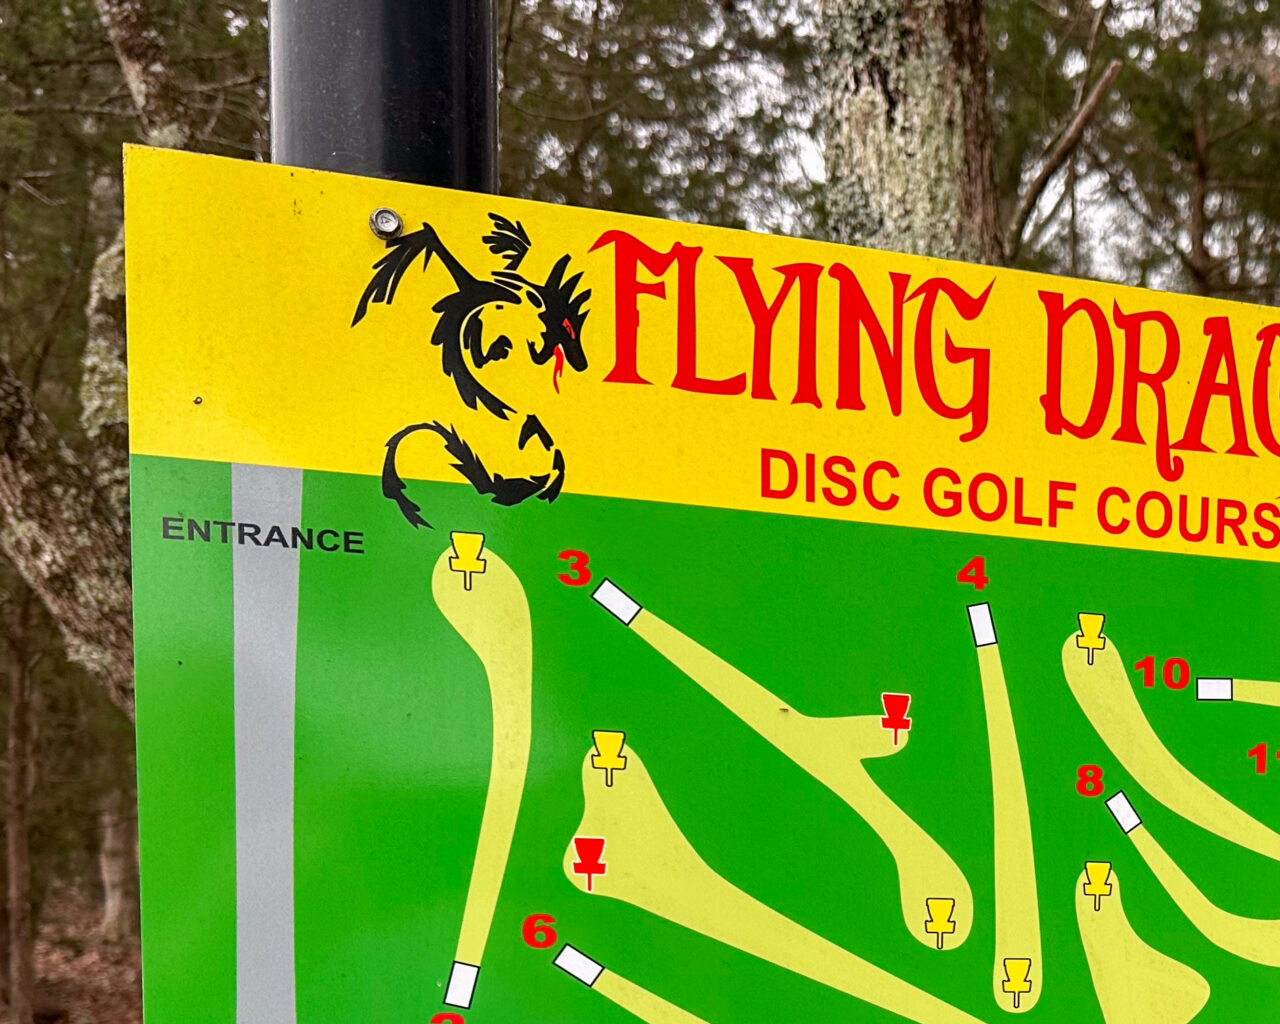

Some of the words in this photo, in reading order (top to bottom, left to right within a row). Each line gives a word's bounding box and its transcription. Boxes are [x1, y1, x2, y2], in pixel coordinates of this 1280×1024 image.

[589, 229, 995, 443] FLYING
[760, 448, 900, 511] DISC
[923, 466, 1078, 528] GOLF
[161, 516, 366, 554] ENTRANCE
[557, 550, 591, 587] 3
[956, 557, 988, 590] 4
[1135, 656, 1190, 690] 10
[1076, 765, 1104, 796] 8
[521, 914, 558, 949] 6
